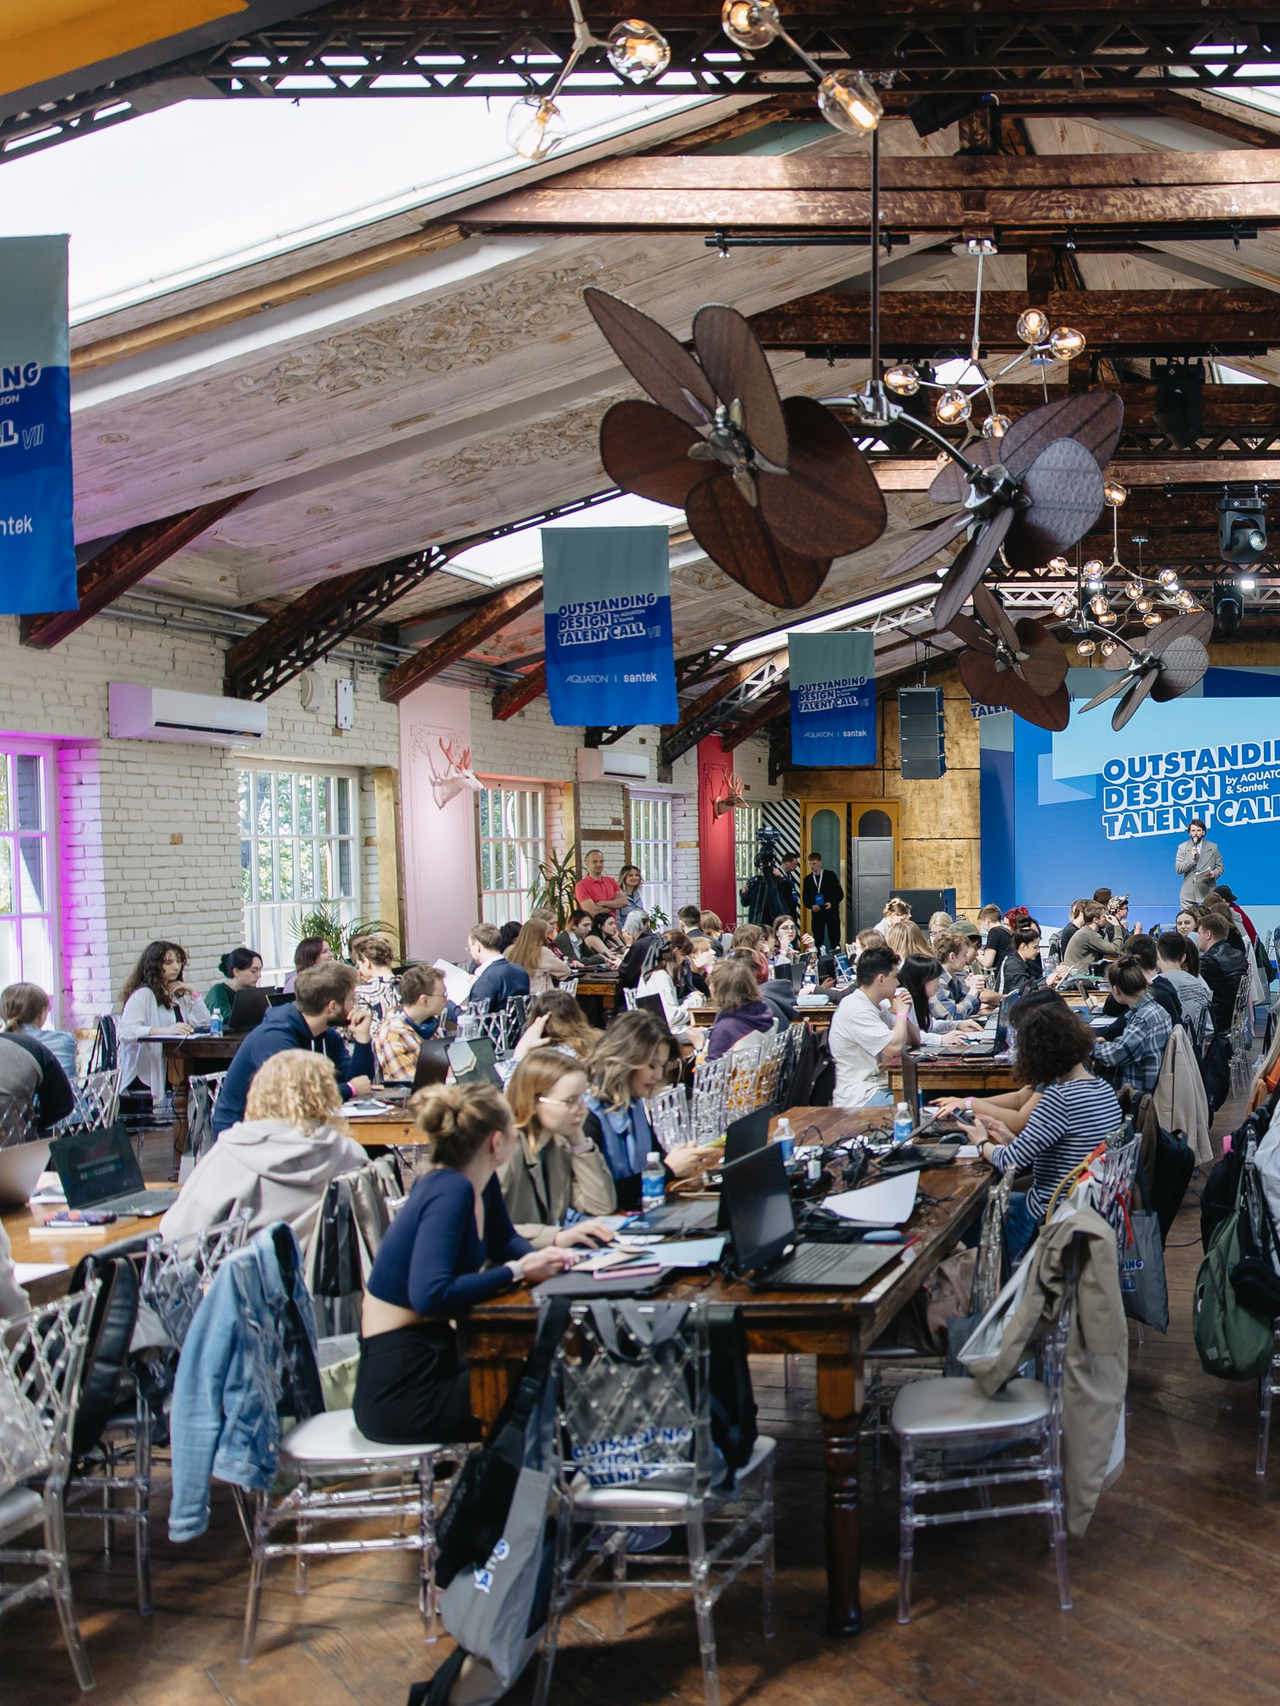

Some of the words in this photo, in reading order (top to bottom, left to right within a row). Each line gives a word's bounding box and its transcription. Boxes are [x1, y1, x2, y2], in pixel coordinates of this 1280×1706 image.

[22, 423, 44, 450] VII
[0, 514, 33, 536] ntek
[558, 592, 658, 617] OUTSTANDING
[558, 612, 612, 632] DESIGN
[558, 627, 609, 646] TALENT
[609, 622, 646, 639] CALL
[565, 674, 608, 683] AQUATON
[623, 672, 657, 682] santek
[798, 676, 867, 693] OUTSTANDING
[798, 689, 836, 704] DESIGN
[798, 699, 833, 713] TALENT
[834, 696, 858, 708] CALL
[803, 731, 833, 739] AQUATON
[843, 729, 867, 738] santek
[1225, 774, 1238, 786] by
[1225, 786, 1234, 795] &
[1236, 780, 1269, 793] Santek
[1102, 774, 1221, 813] DESIGN
[1102, 802, 1215, 840] TALENT
